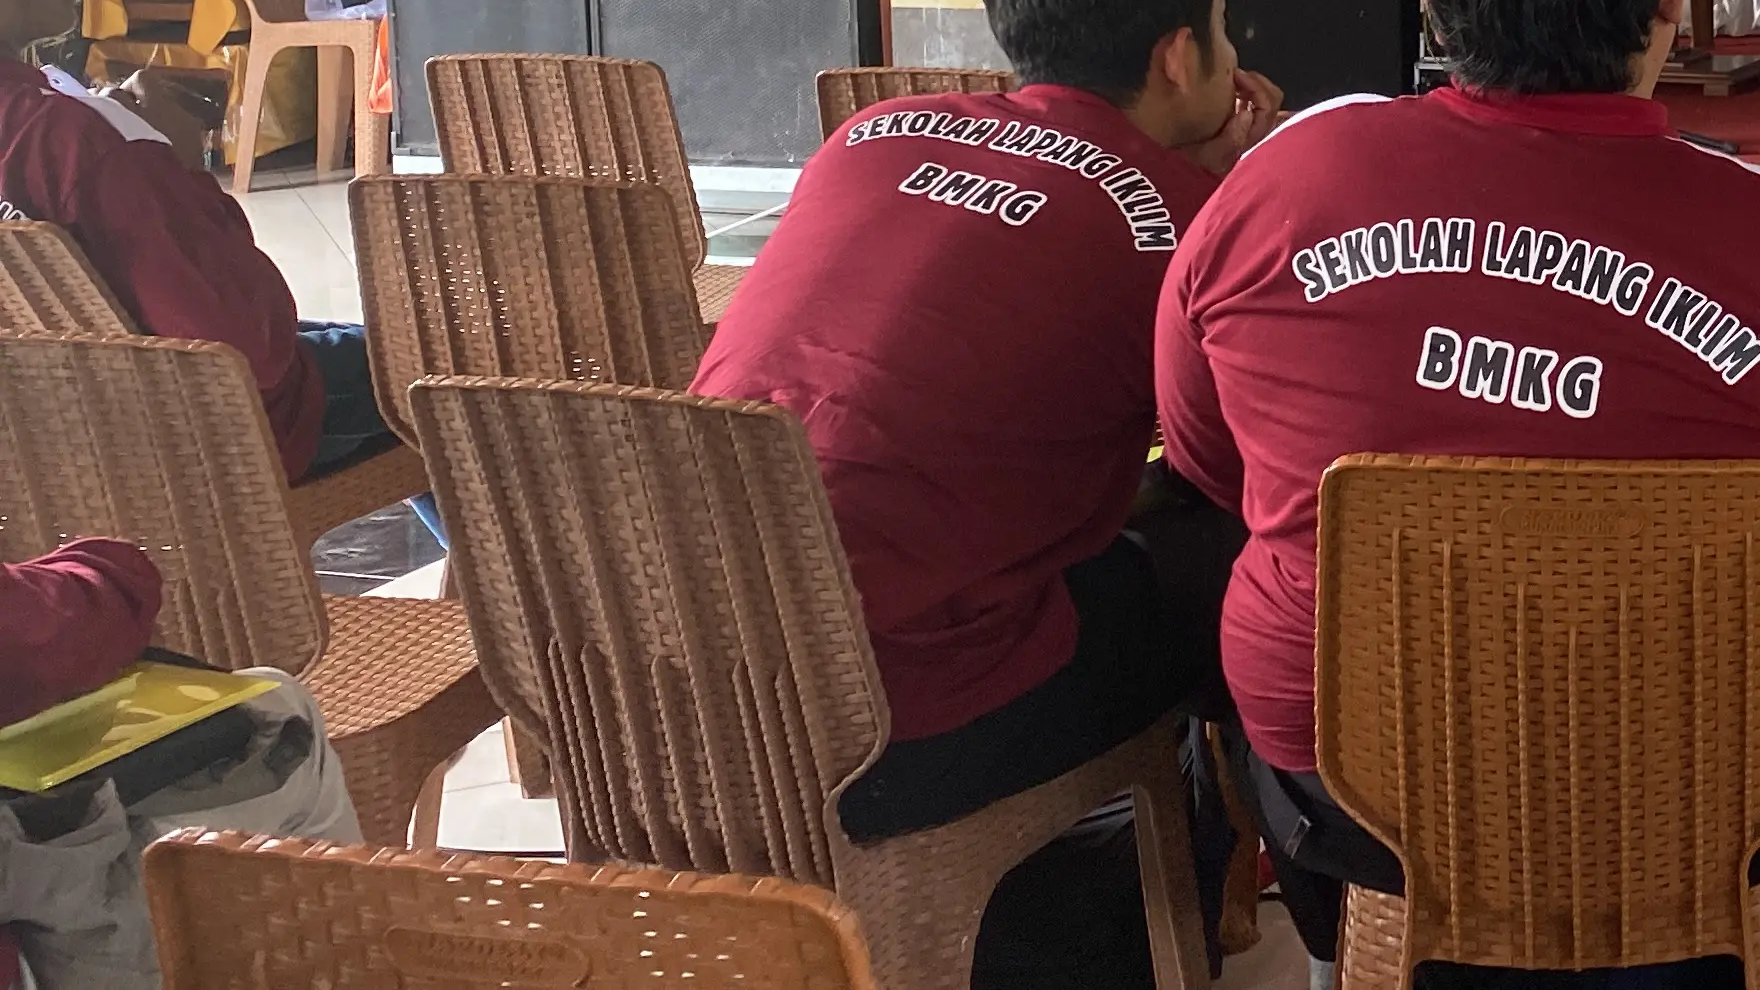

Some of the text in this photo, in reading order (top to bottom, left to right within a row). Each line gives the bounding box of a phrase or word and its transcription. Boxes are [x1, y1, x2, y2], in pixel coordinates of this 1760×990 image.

[846, 111, 1177, 251] SEKOLAH LAPANG IKLIM
[899, 162, 1047, 226] BMKG
[1293, 217, 1475, 302] SEKOLAH
[1482, 221, 1654, 316] LAPANG
[1416, 326, 1603, 418] BMKG
